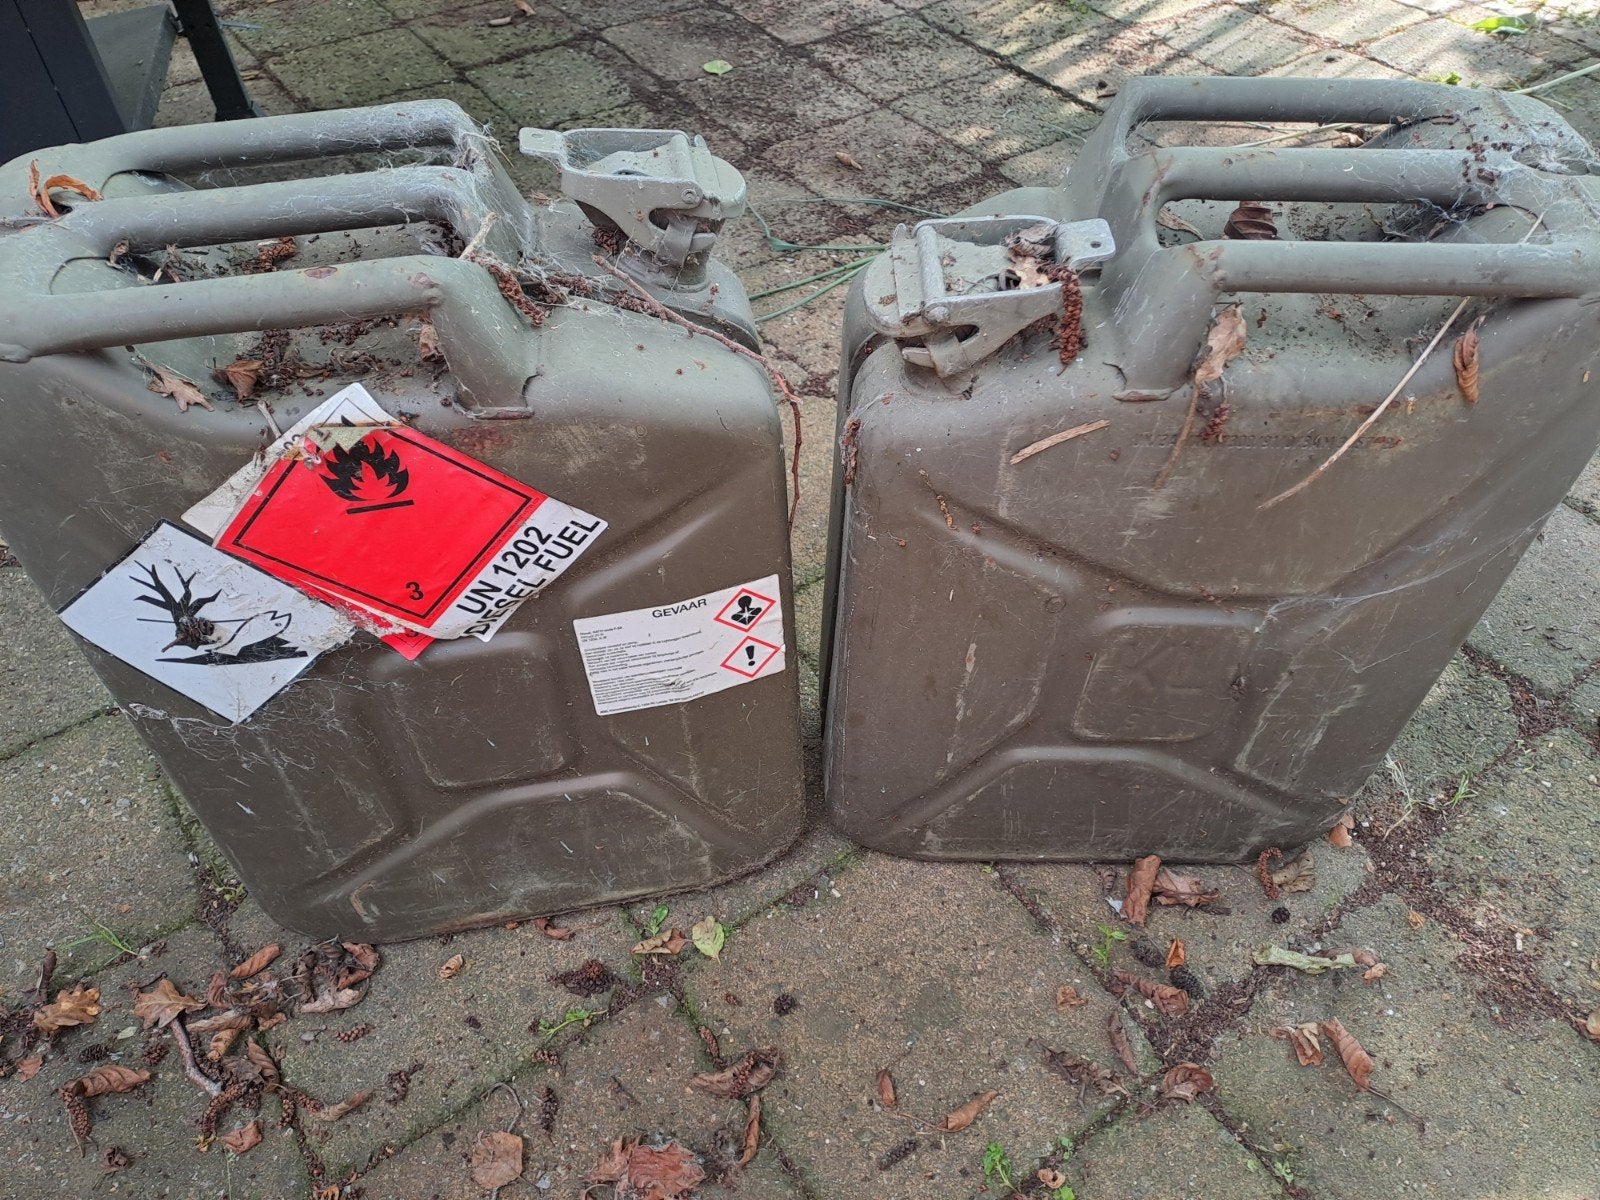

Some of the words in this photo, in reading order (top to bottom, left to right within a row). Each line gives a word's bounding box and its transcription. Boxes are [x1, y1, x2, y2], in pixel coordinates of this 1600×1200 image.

[405, 581, 424, 601] 3
[456, 580, 503, 614] UN
[492, 526, 553, 577] 1202
[463, 578, 547, 635] DIESEL
[532, 520, 600, 573] FUEL
[652, 598, 707, 618] GEVAAR
